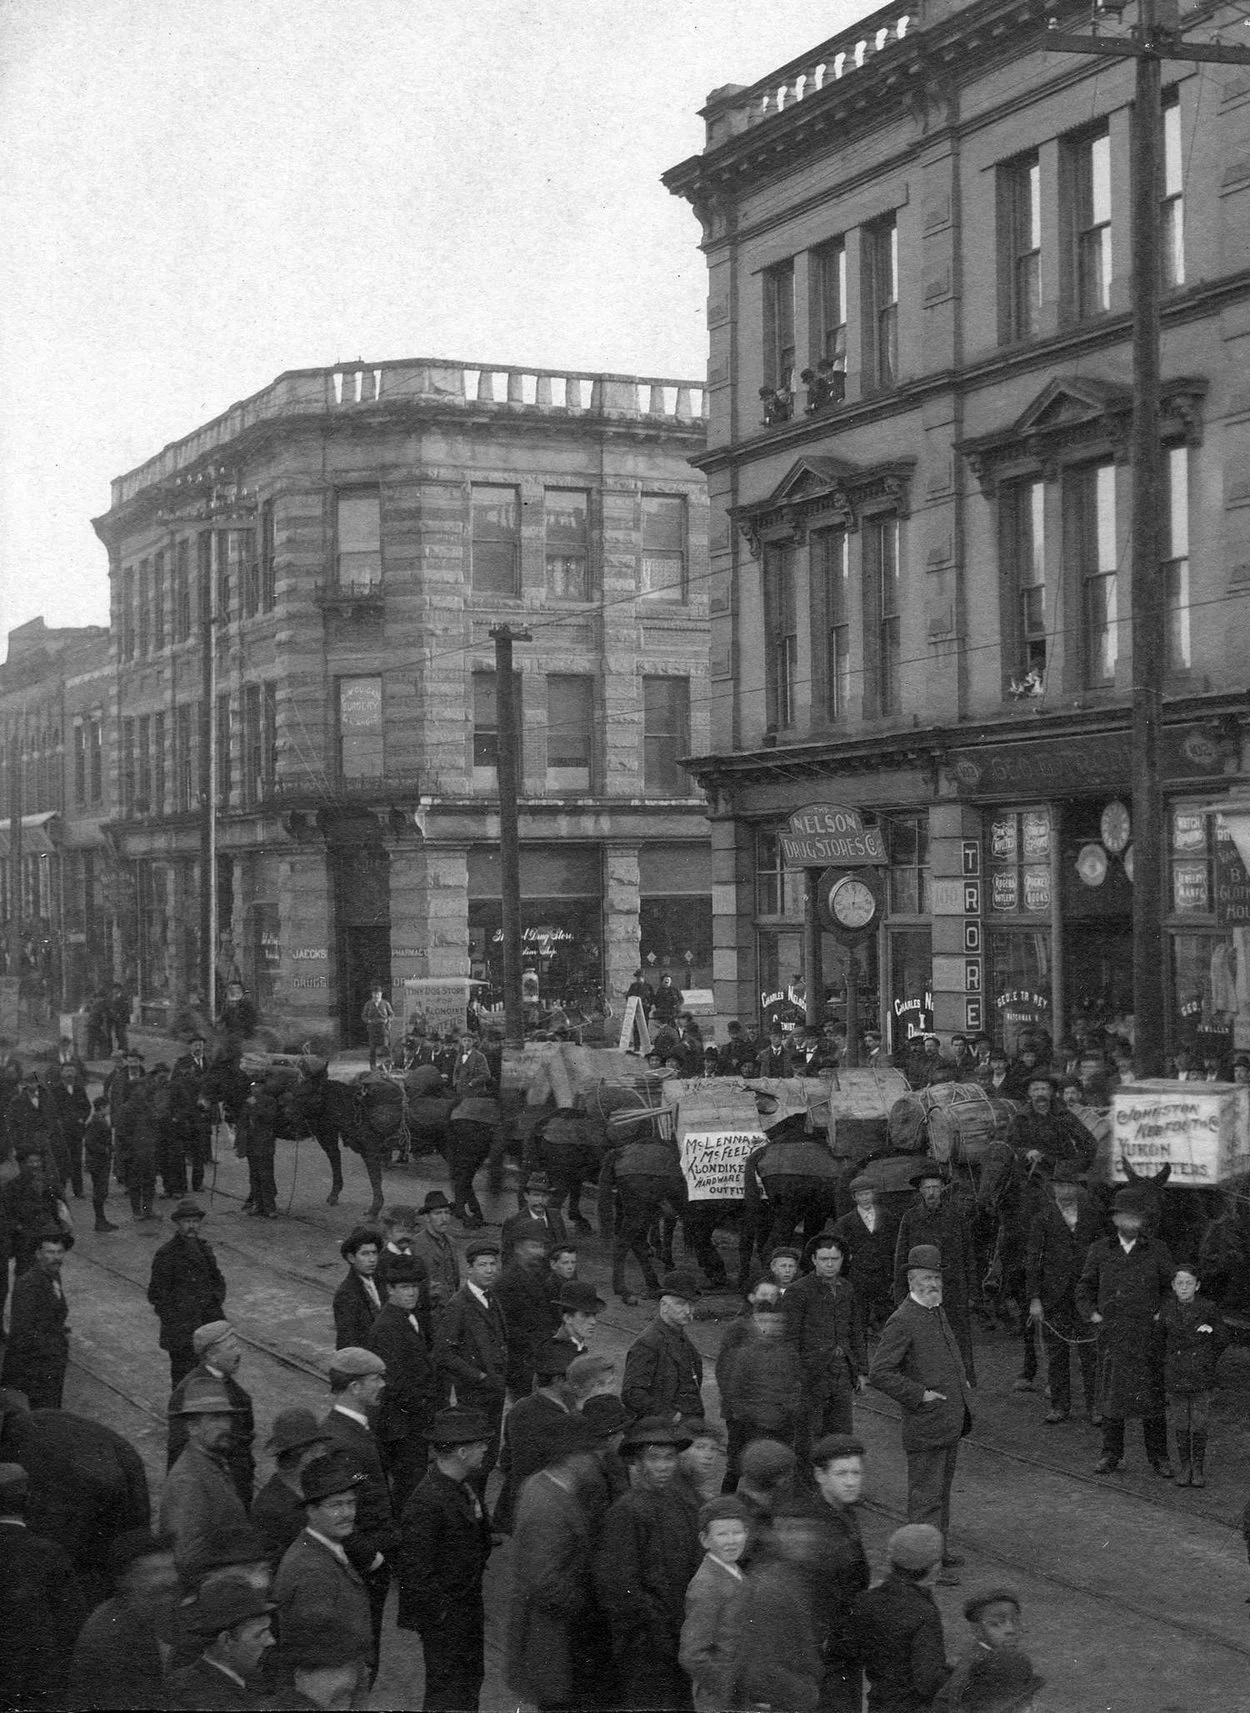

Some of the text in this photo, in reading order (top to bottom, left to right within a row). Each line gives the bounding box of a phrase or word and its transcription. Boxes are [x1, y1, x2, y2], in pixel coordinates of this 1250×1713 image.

[793, 814, 860, 835] NELSON
[783, 839, 817, 859] DRUG
[815, 837, 865, 858] STORES
[293, 976, 328, 989] DRUGS
[894, 998, 921, 1017] CHARLES
[1117, 1138, 1171, 1157] YUKON
[688, 1156, 746, 1181] KLONDIKE
[694, 1174, 741, 1189] HARDWARE
